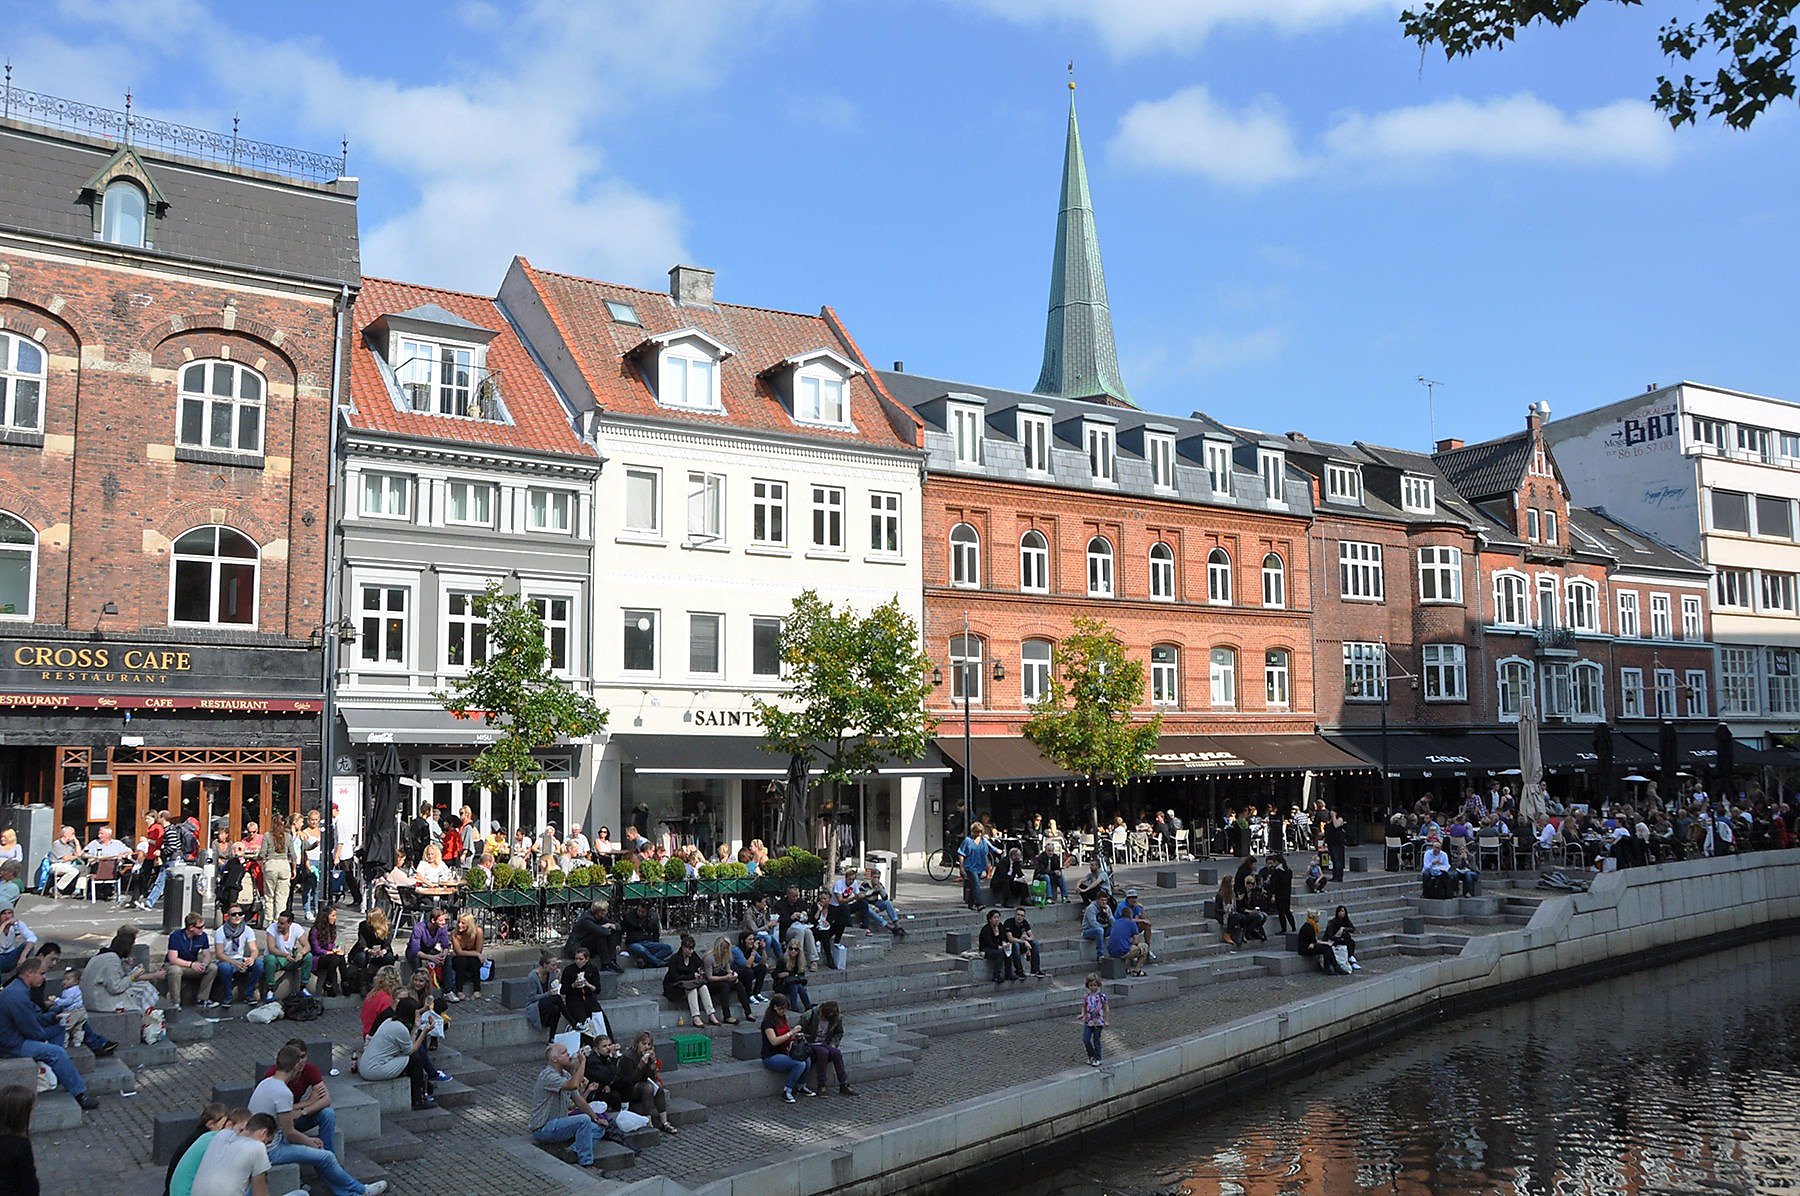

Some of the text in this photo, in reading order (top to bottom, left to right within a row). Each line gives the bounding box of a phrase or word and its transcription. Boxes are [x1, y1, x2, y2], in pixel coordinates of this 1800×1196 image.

[14, 646, 191, 671] CROSS CAFE
[42, 671, 168, 684] RESTAURANT
[0, 695, 69, 705] ESTAURANT
[145, 698, 173, 707] CAFE
[200, 699, 269, 710] RESTAURANT
[695, 710, 754, 726] SAINT
